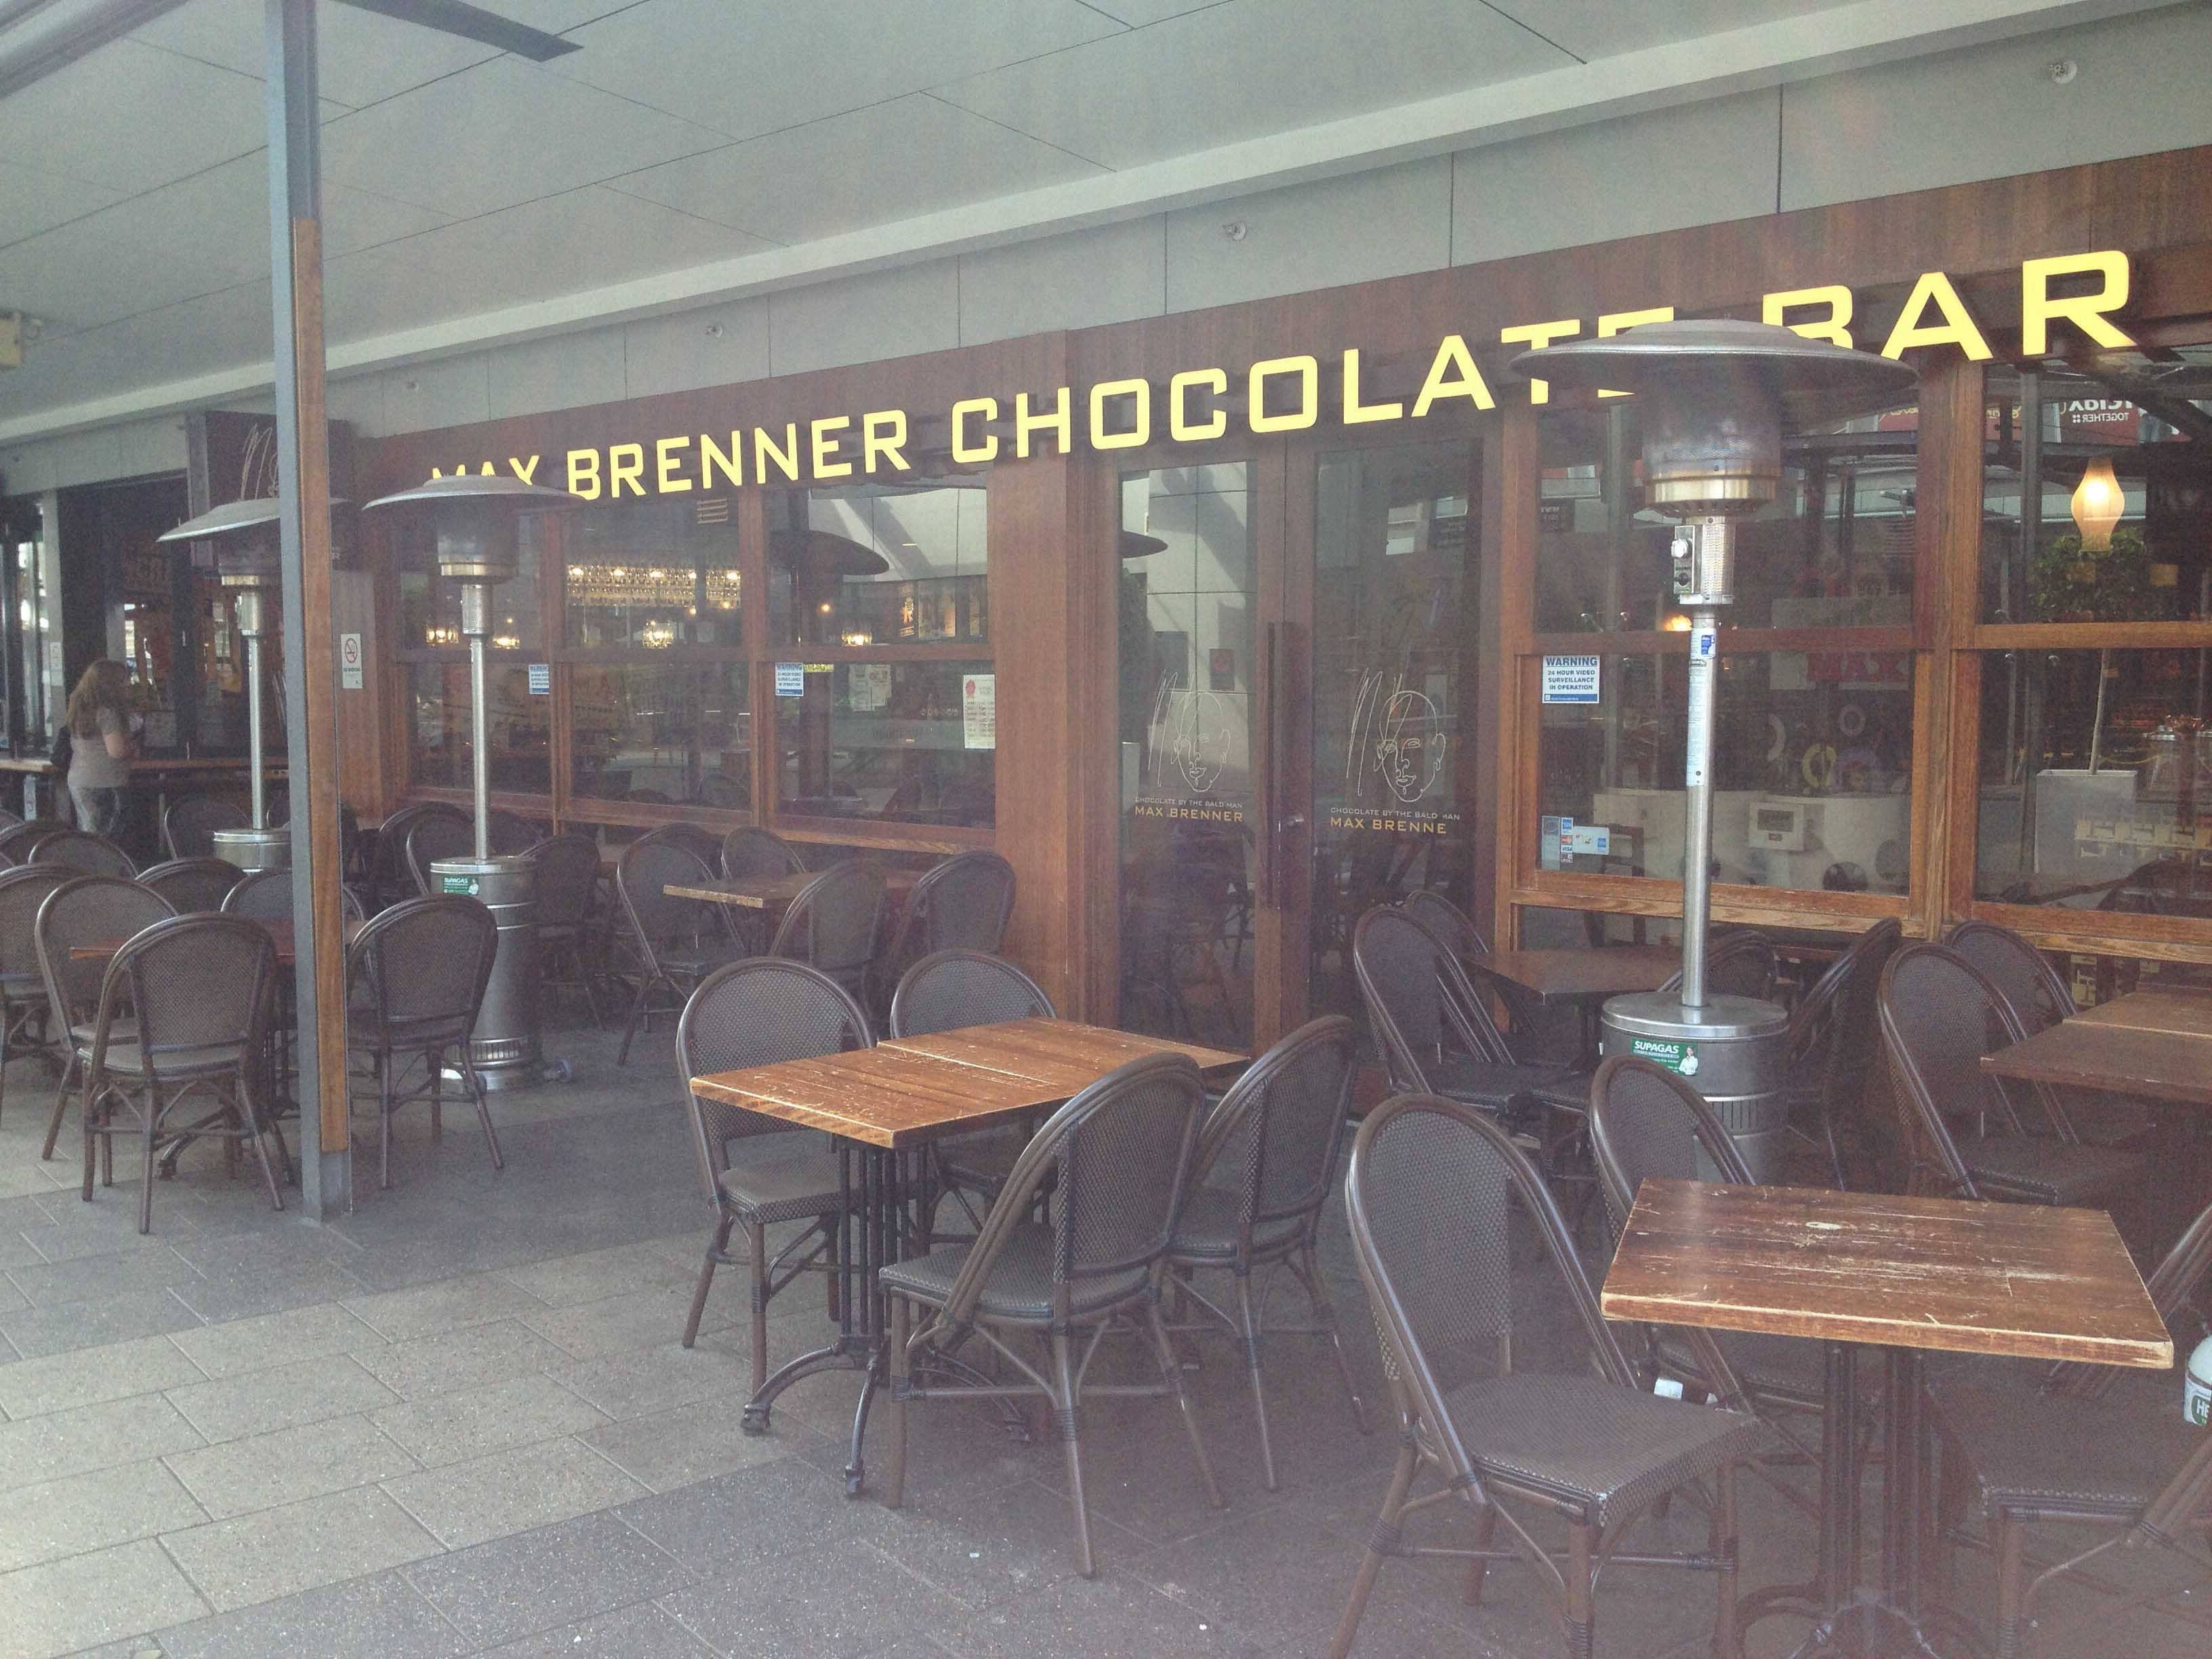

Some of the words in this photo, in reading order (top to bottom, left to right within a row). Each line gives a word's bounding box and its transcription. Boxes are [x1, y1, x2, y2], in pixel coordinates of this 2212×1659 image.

[567, 409, 912, 501] BRENNER
[1761, 249, 2136, 361] BAR
[1546, 657, 1597, 666] WARNING
[1135, 796, 1176, 805] CHOCOLATE
[1134, 806, 1164, 817] MAX
[1170, 808, 1243, 822] BRENNER
[1330, 807, 1380, 816] CHOCOLATE
[1414, 811, 1438, 819] BALD
[1330, 817, 1365, 829] MAX
[1372, 819, 1447, 834] BRENNE
[1634, 1040, 1680, 1054] SUPAGAS
